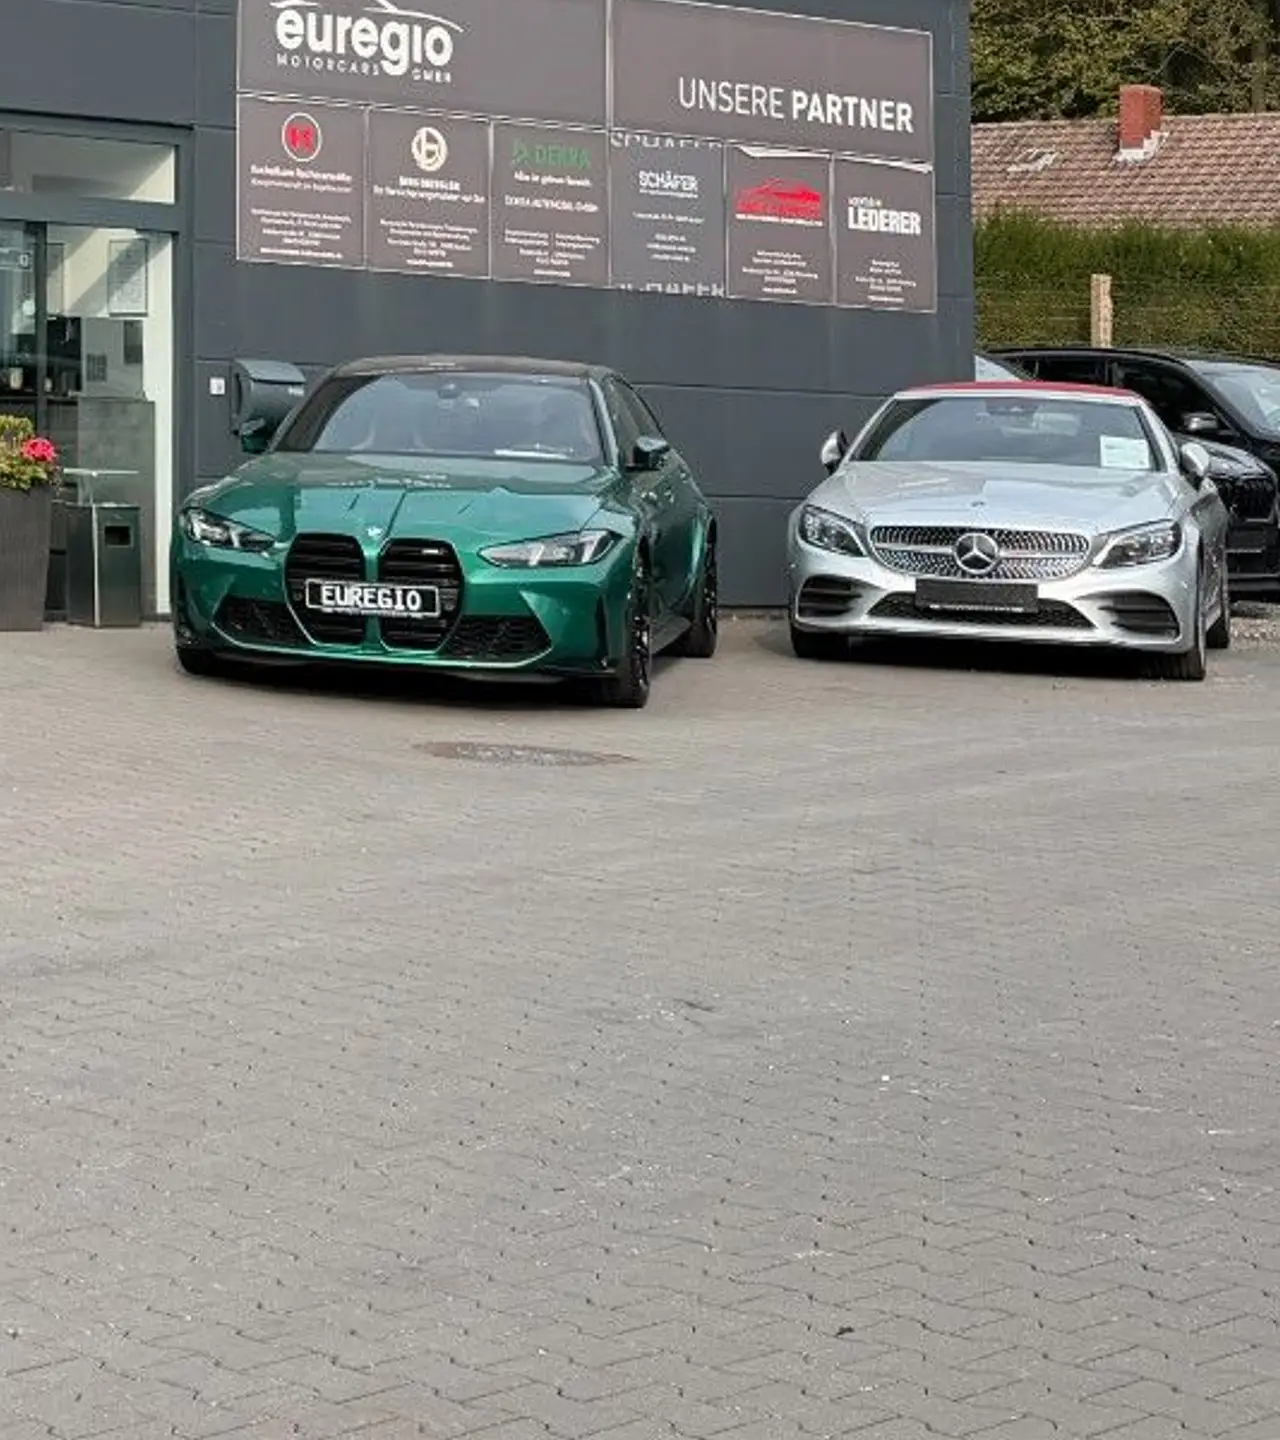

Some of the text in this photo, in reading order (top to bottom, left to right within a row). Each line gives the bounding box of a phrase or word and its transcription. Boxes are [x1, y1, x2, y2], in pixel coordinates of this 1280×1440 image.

[275, 9, 454, 76] euregio
[276, 52, 380, 76] MOTORCARS
[678, 76, 914, 134] UNSERE PARTNER
[847, 206, 921, 235] LEDERER
[320, 584, 422, 611] EUREGIO
